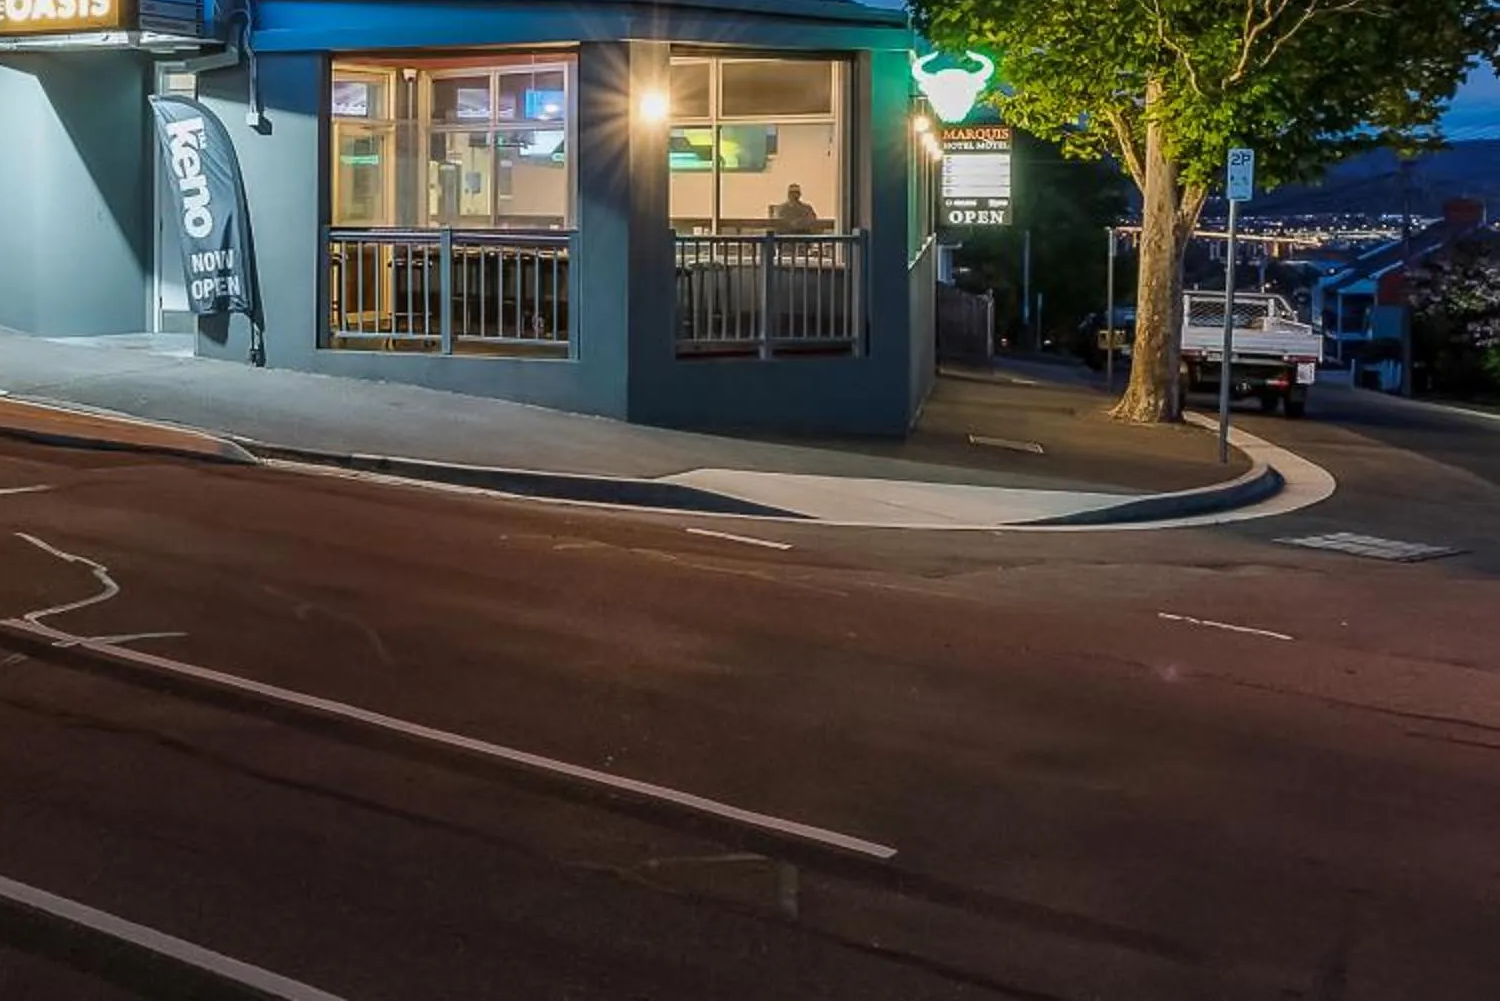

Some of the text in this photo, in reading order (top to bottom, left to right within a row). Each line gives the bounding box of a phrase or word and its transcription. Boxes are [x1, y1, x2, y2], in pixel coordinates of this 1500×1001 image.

[943, 128, 1009, 142] MARQUIS
[1231, 152, 1251, 166] 2P
[948, 210, 1005, 225] OPEN
[191, 250, 234, 273] NOW
[191, 277, 240, 300] OPEN
